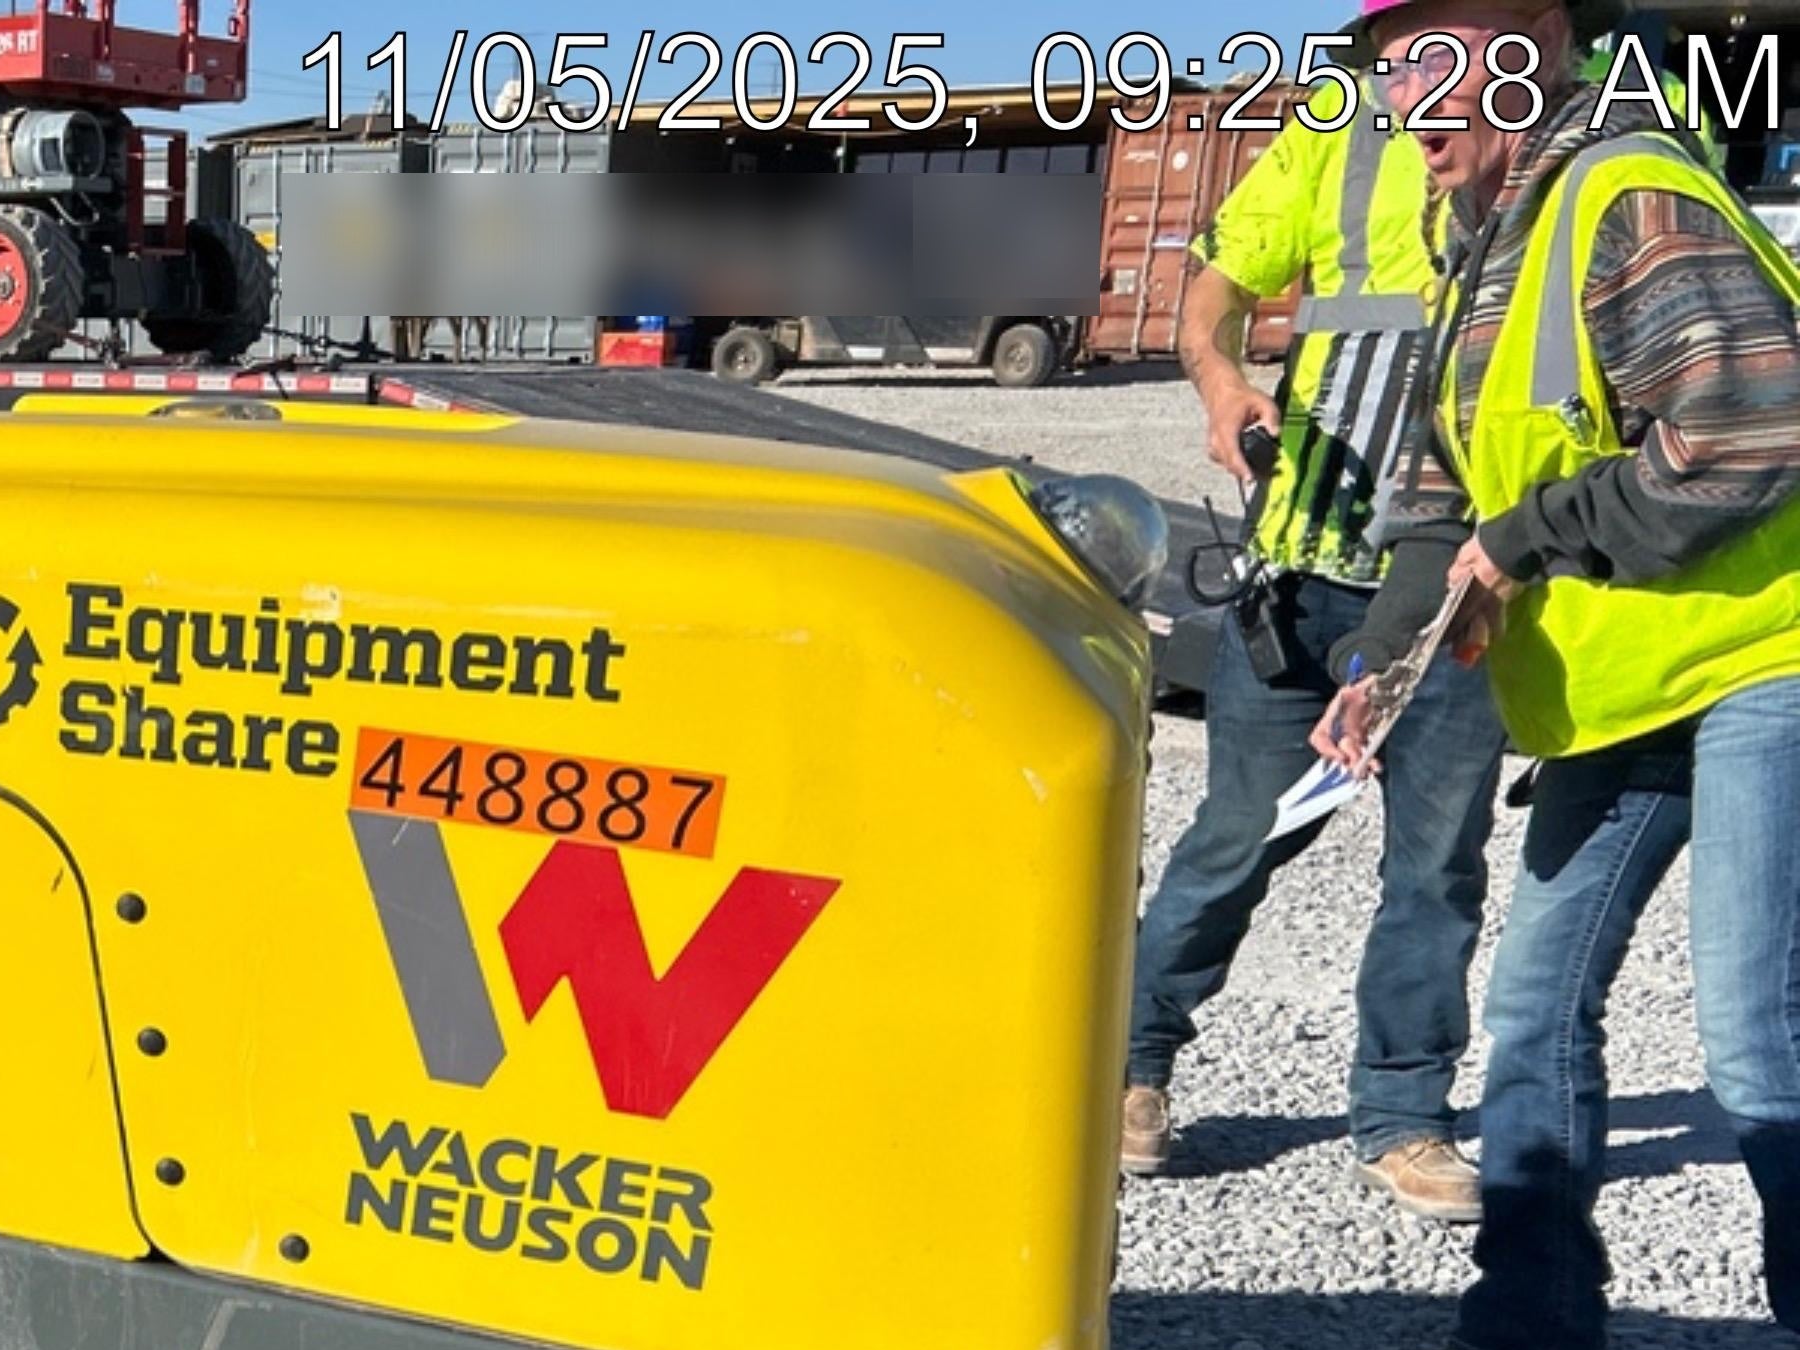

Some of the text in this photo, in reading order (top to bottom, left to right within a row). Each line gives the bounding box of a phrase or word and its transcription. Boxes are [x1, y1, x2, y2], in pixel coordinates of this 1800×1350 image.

[16, 29, 38, 54] RT
[64, 583, 625, 702] Equipment
[60, 679, 340, 778] Share
[359, 737, 714, 850] 448887
[350, 1112, 714, 1233] WACKER
[345, 1171, 713, 1292] NEUSON
